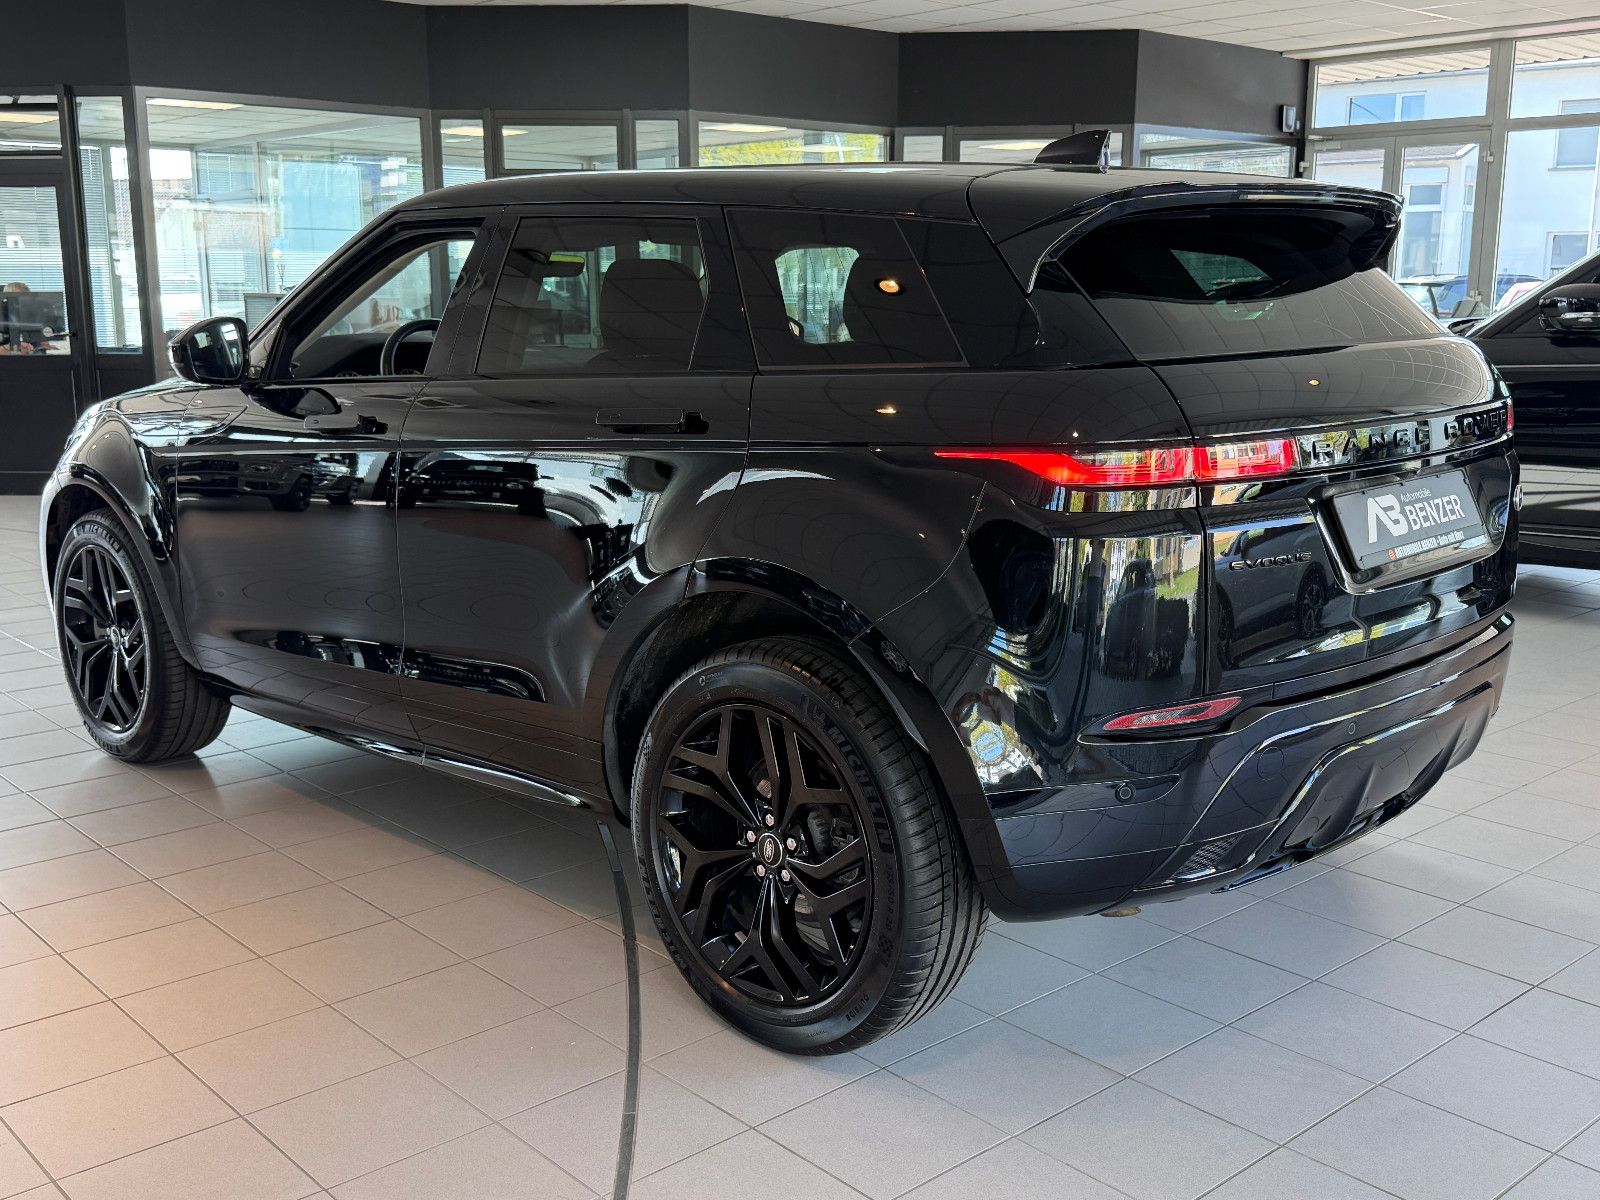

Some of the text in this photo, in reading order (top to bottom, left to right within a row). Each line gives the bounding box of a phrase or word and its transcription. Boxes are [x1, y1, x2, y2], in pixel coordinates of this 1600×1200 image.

[1312, 409, 1507, 462] RANGE ROVER
[1400, 487, 1432, 503] Automobile
[1403, 494, 1466, 531] BENZER
[84, 524, 121, 551] MICHELIN
[827, 725, 893, 849] MICHELIN
